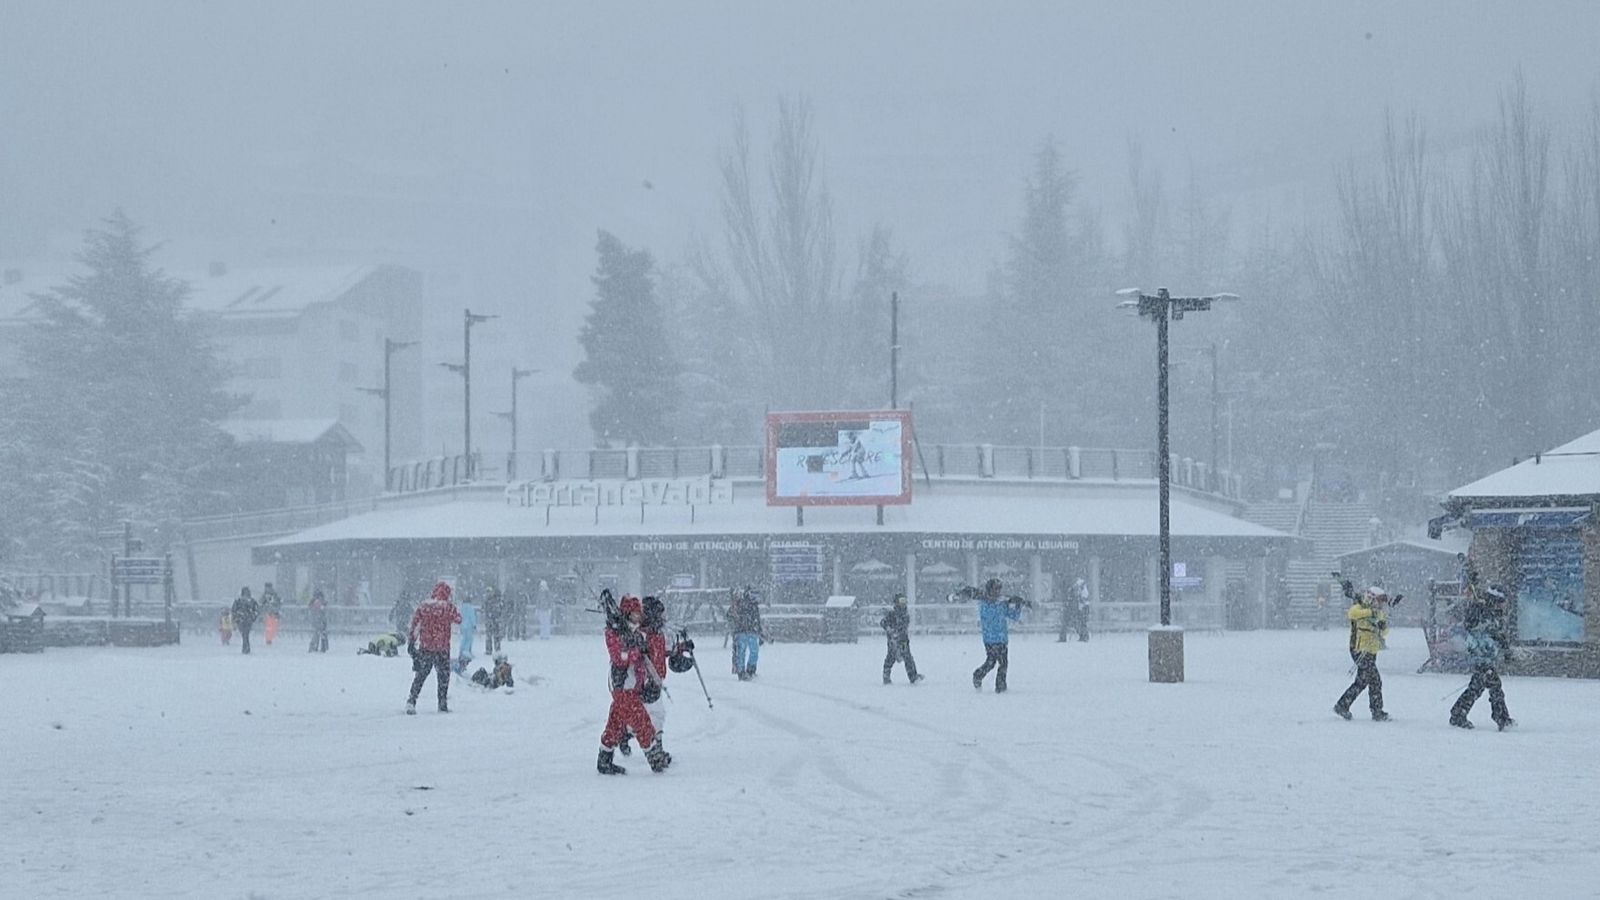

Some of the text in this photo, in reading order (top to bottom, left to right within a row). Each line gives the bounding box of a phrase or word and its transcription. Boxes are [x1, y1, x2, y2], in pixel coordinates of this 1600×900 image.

[632, 541, 672, 551] CENTRO
[675, 541, 689, 551] DE
[747, 541, 760, 550] AL
[922, 540, 960, 549] CENTRO
[961, 540, 974, 549] DE
[1023, 540, 1035, 549] AL
[1038, 540, 1079, 549] USUARIO
